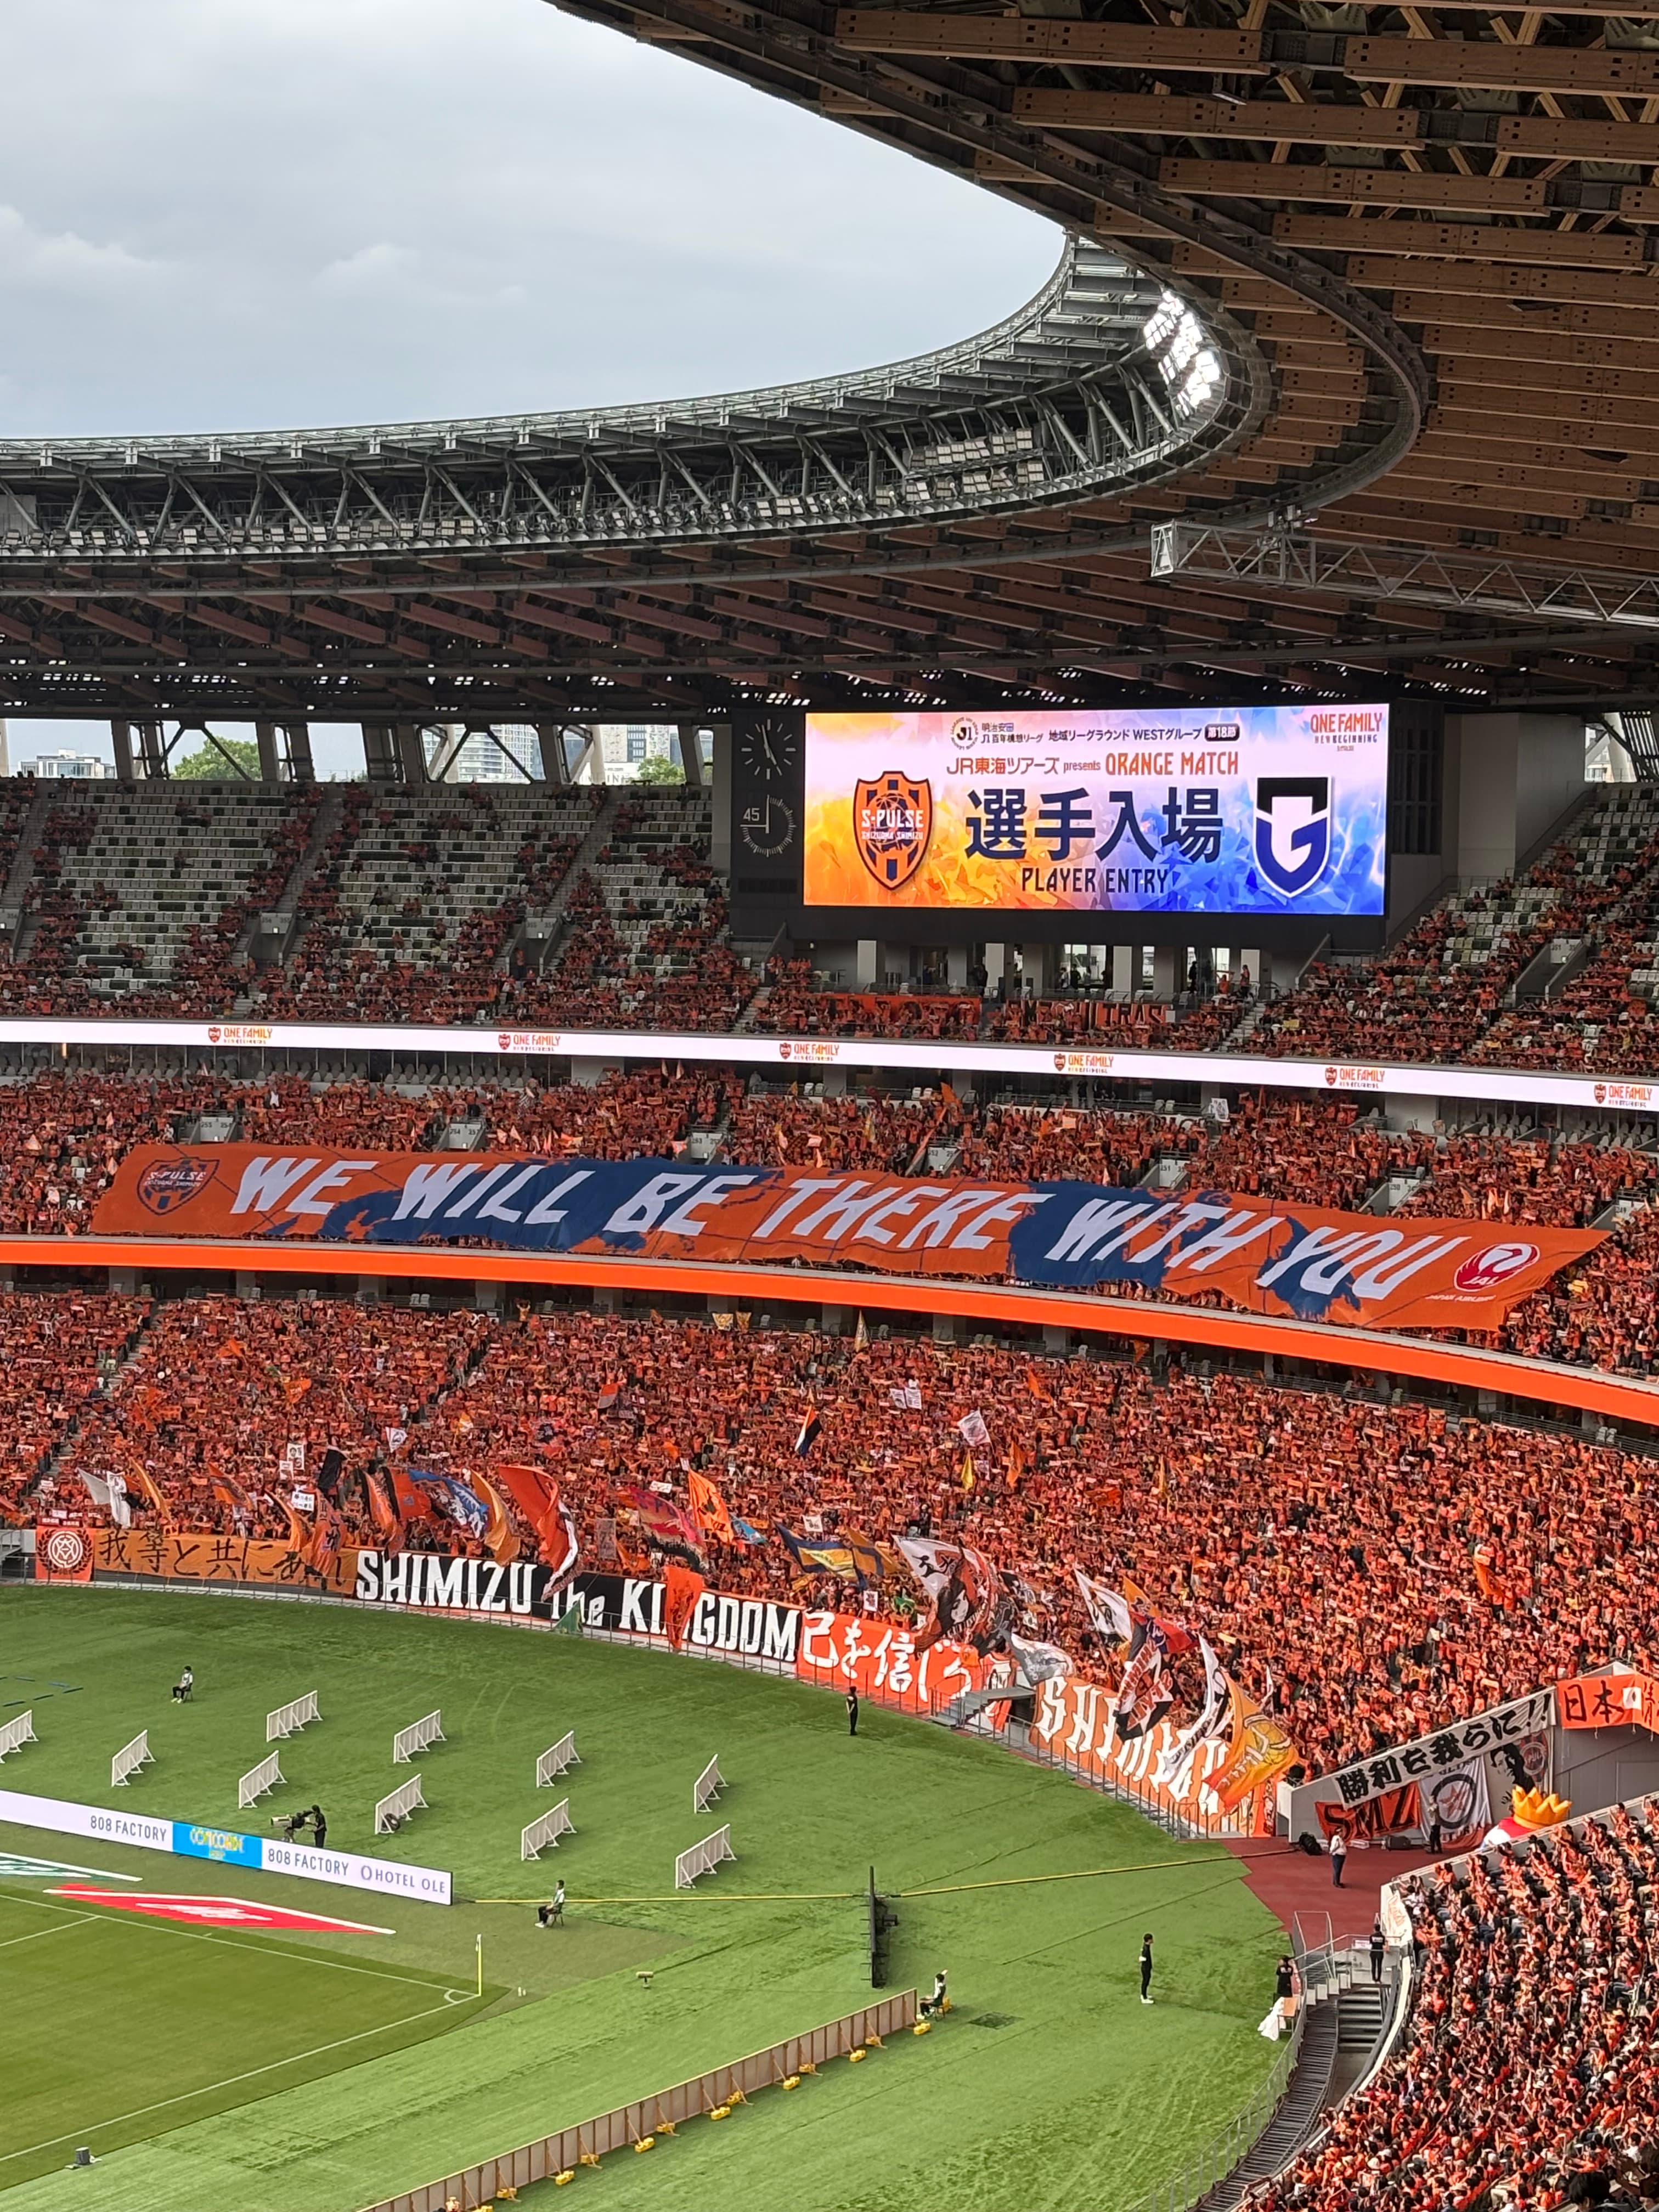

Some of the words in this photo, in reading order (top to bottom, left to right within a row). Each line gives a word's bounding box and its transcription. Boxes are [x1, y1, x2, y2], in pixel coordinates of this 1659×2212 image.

[1310, 714, 1336, 733] ONE
[1339, 712, 1383, 732] FAMILY
[1048, 729, 1130, 741] 地域リーグラウンド
[1133, 727, 1202, 741] WESTグループ
[946, 757, 1060, 775] JR東海ツアーズ
[1063, 760, 1101, 774] presents
[1105, 752, 1174, 776] ORANGE
[1180, 751, 1239, 776] MATCH
[742, 807, 760, 821] 45
[861, 809, 924, 828] S-PULSE
[964, 787, 1223, 862] 選手入場
[1022, 867, 1096, 893] PLAYER
[1105, 868, 1168, 894] ENTRY
[224, 1027, 240, 1039] ONE
[243, 1027, 272, 1039] FAMILY
[514, 1035, 530, 1045] ONE
[532, 1035, 561, 1046] FAMILY
[794, 1043, 809, 1054] ONE
[811, 1043, 840, 1056] FAMILY
[1068, 1054, 1084, 1066] ONE
[1086, 1054, 1114, 1068] FAMILY
[1339, 1068, 1355, 1080] ONE
[1357, 1069, 1385, 1082] FAMILY
[1609, 1085, 1624, 1099] ONE
[1625, 1086, 1652, 1101] FAMILY
[146, 1171, 207, 1181] S-PULSE
[230, 1156, 380, 1215] WE
[391, 1163, 596, 1224] WILL
[602, 1172, 760, 1237] BE
[751, 1178, 1057, 1250] THERE
[1044, 1199, 1286, 1271] WITH
[1254, 1225, 1473, 1300] YOU
[1462, 1276, 1500, 1285] JAL
[357, 1549, 538, 1615] SHIMIZU
[619, 1577, 800, 1662] KIGDOM
[91, 1815, 112, 1831] 808
[115, 1820, 167, 1842] FACTORY
[268, 1848, 291, 1865] 808
[295, 1853, 349, 1876] FACTORY
[375, 1868, 415, 1888] HOTEL
[421, 1877, 445, 1894] OLE
